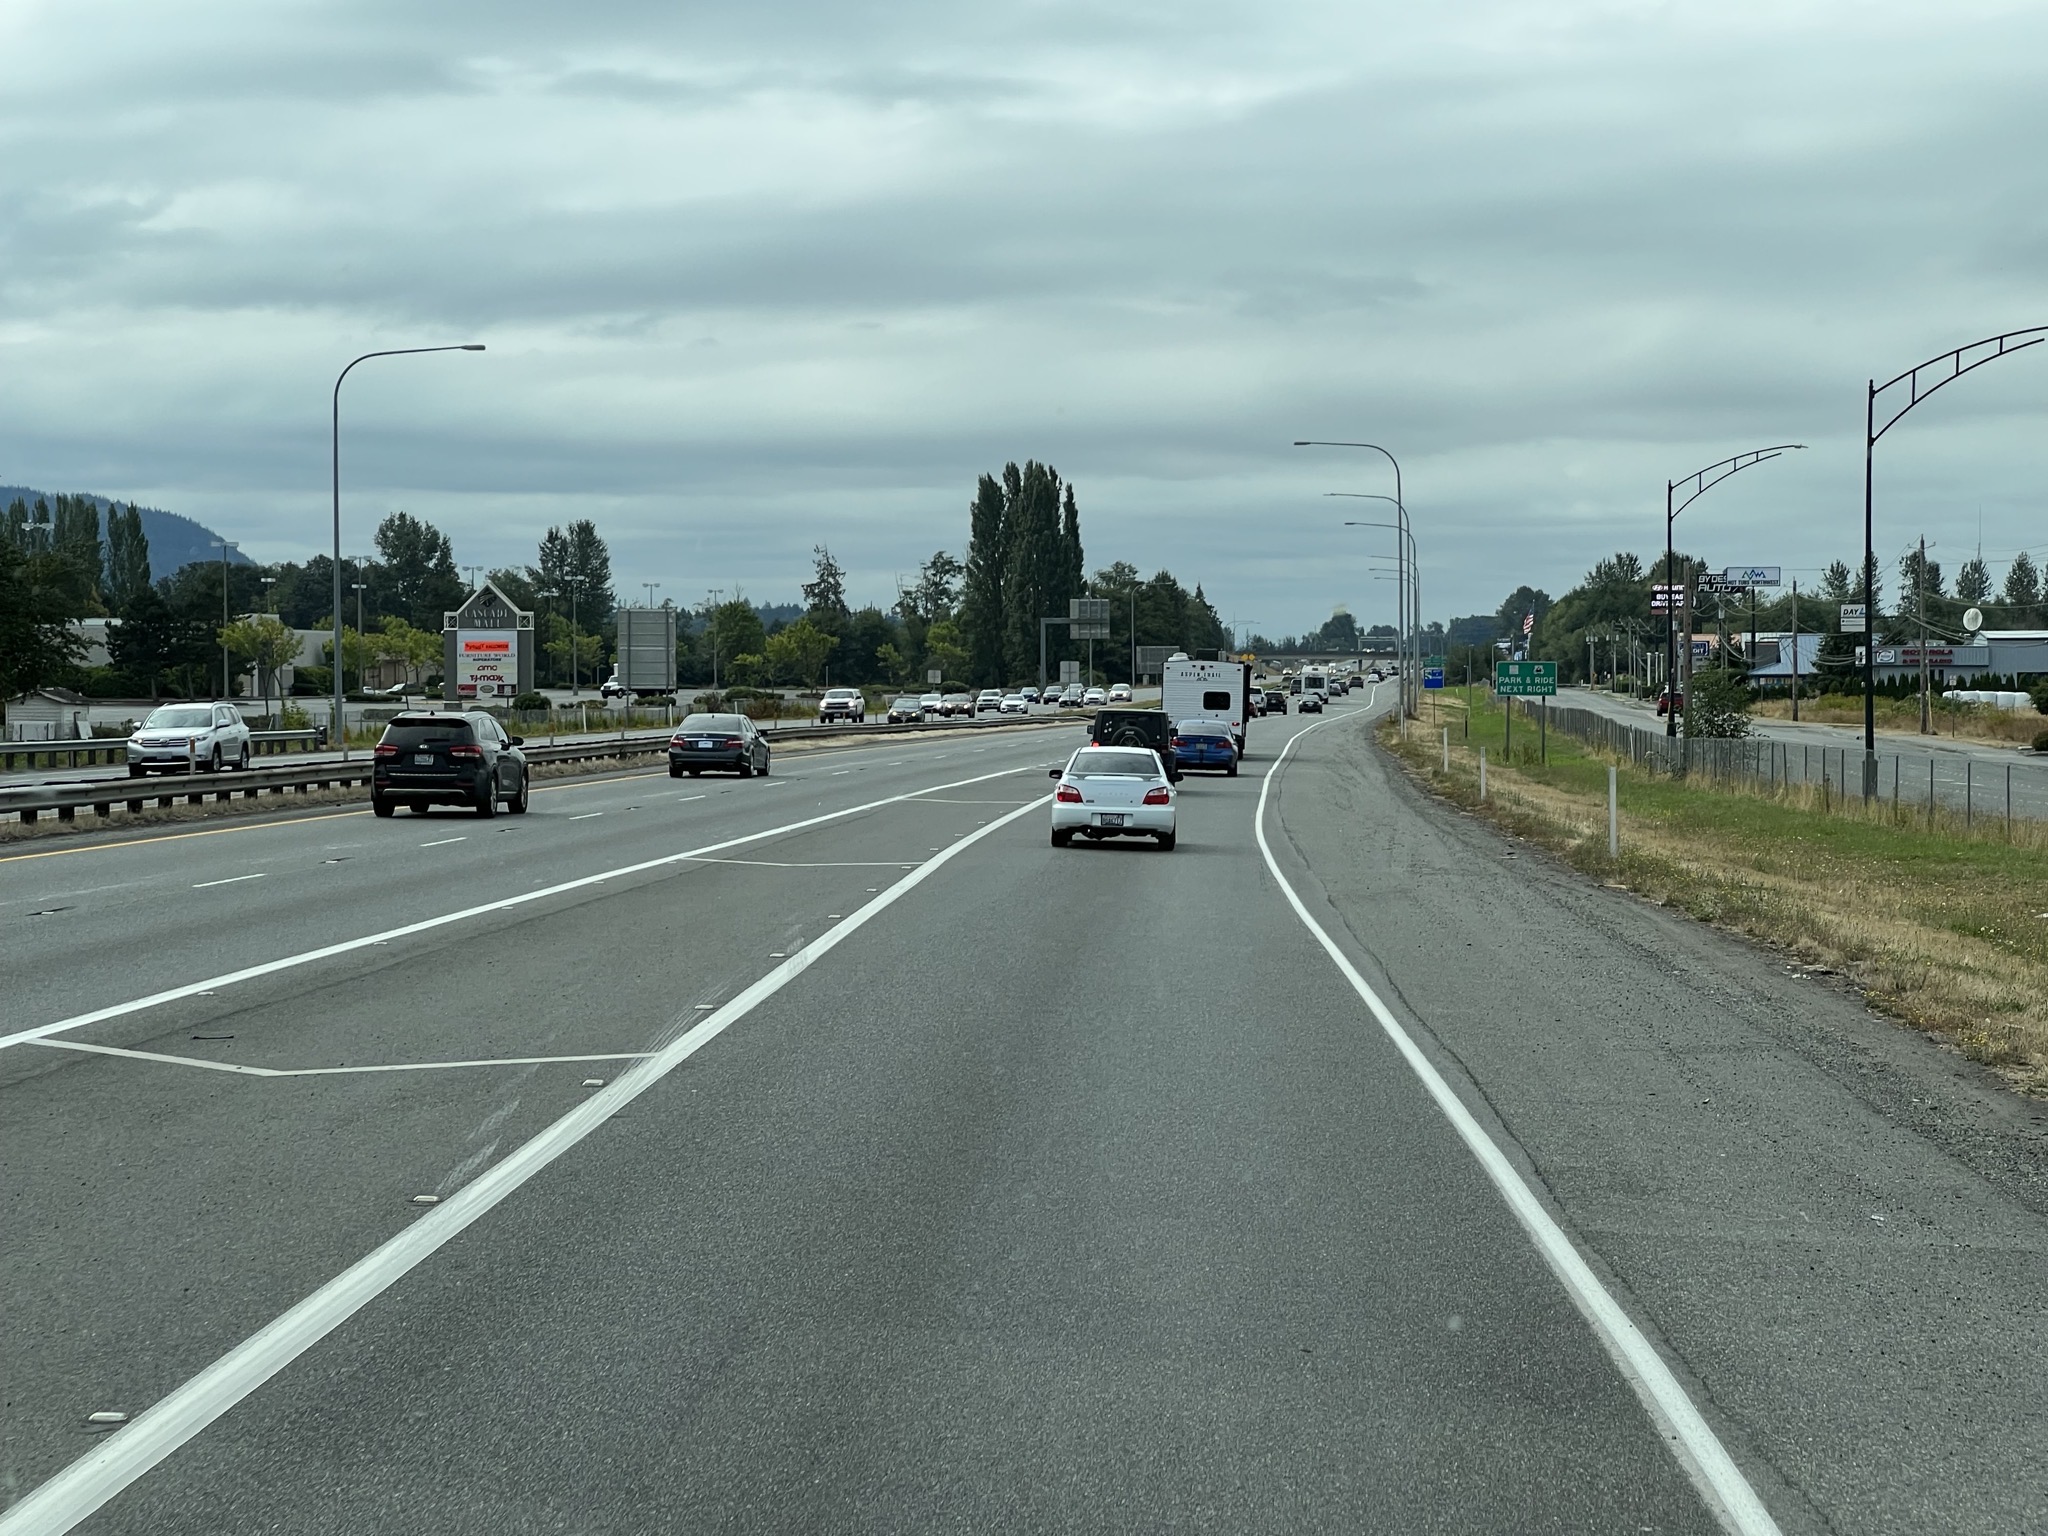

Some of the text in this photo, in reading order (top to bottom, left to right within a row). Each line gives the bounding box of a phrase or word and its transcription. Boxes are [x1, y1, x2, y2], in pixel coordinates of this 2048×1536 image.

[464, 608, 508, 618] CASCADE
[473, 618, 501, 628] MALL
[1498, 676, 1555, 684] PARK & RIDE
[1500, 685, 1553, 693] NEXT RIGHT
